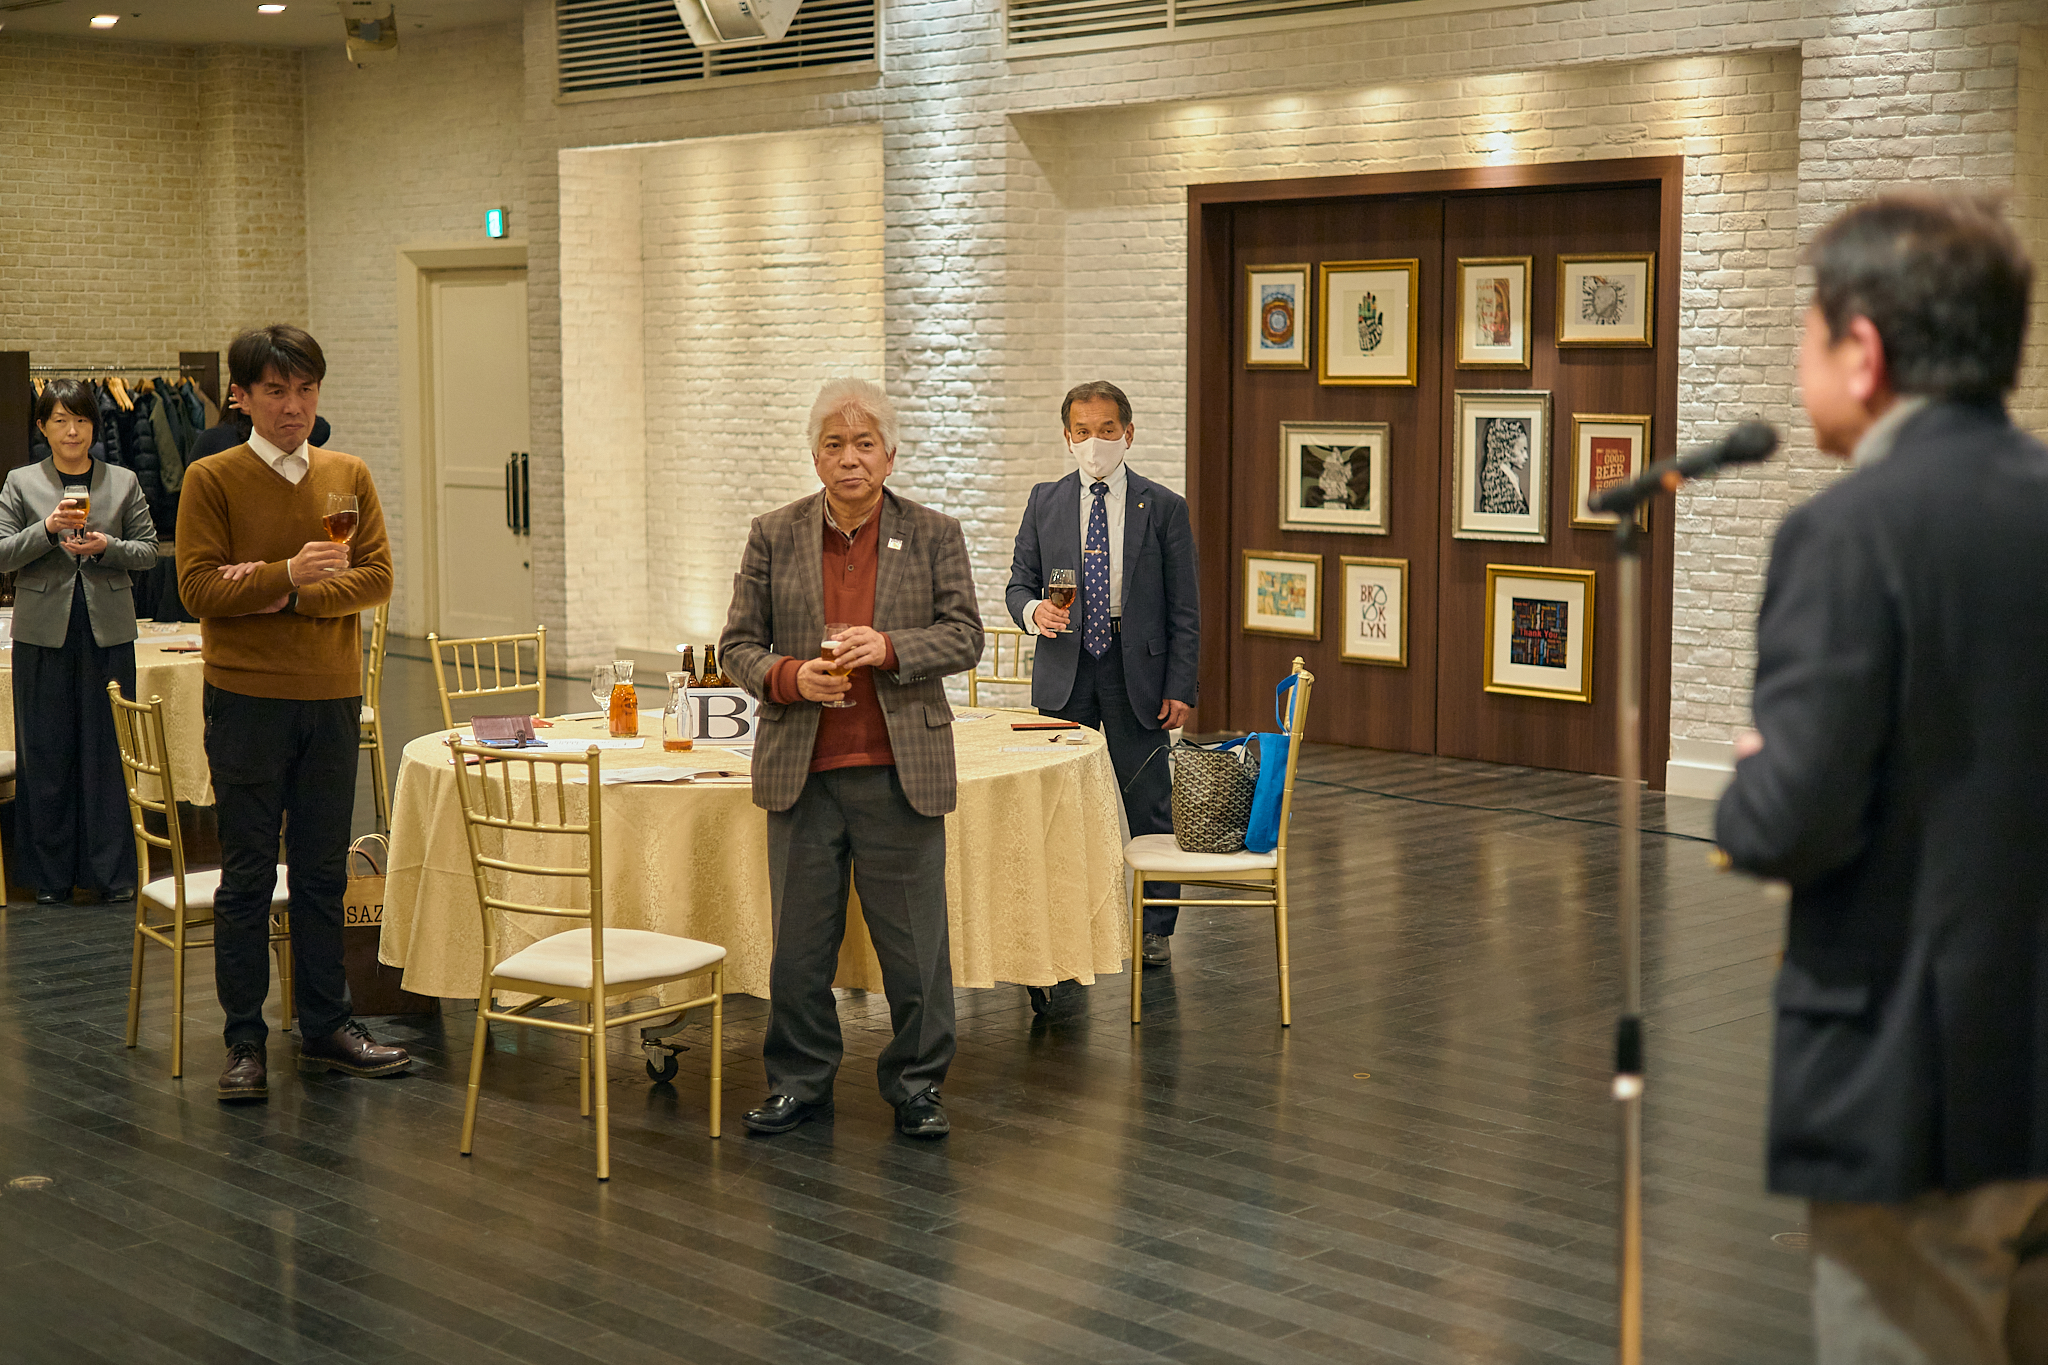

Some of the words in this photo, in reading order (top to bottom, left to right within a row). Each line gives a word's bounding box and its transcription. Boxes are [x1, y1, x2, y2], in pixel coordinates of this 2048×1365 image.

[1604, 453, 1626, 465] GOOD
[1595, 463, 1625, 480] BEER
[1360, 621, 1387, 639] LYN
[1519, 627, 1542, 638] Thank
[1543, 629, 1559, 640] You
[689, 695, 751, 740] B
